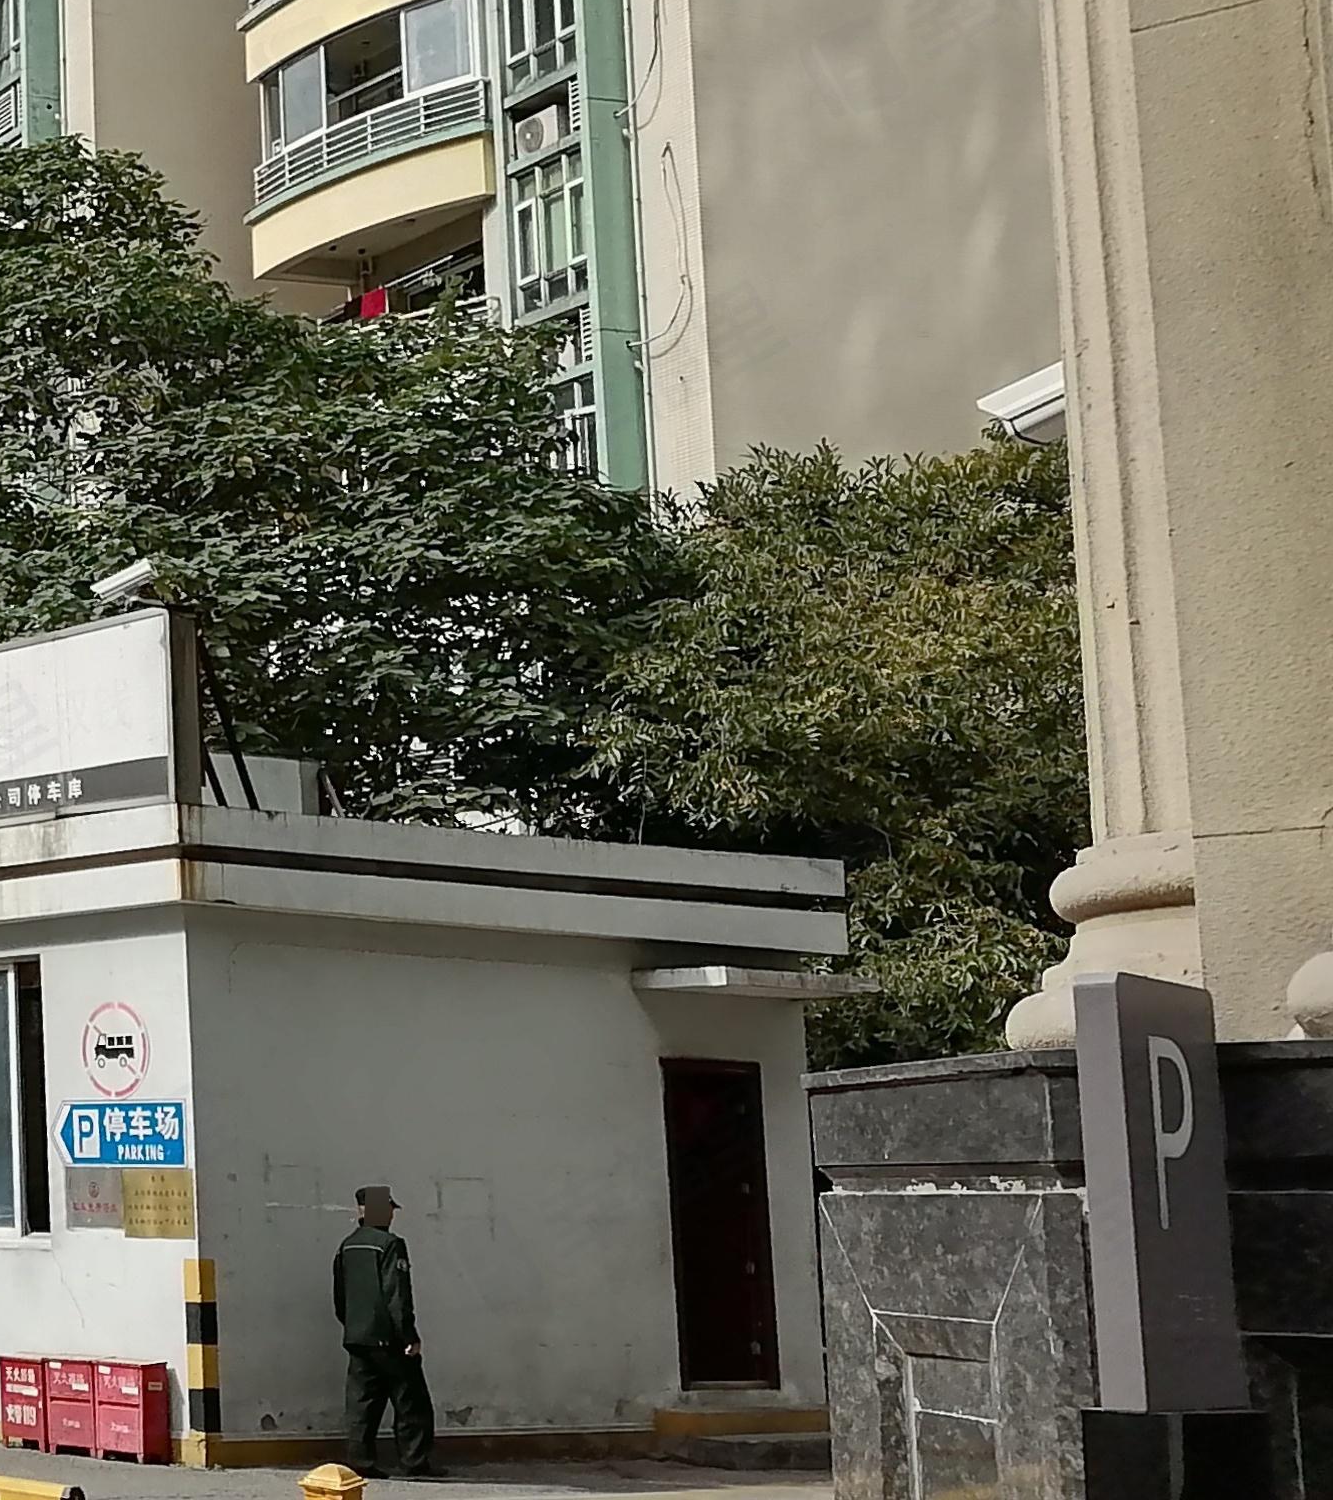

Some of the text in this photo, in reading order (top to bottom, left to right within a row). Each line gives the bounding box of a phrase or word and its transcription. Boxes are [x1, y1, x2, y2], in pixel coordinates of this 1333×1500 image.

[78, 1114, 94, 1153] P
[103, 1106, 180, 1142] 停车场
[1148, 1035, 1194, 1230] P
[117, 1144, 165, 1161] PARKING
